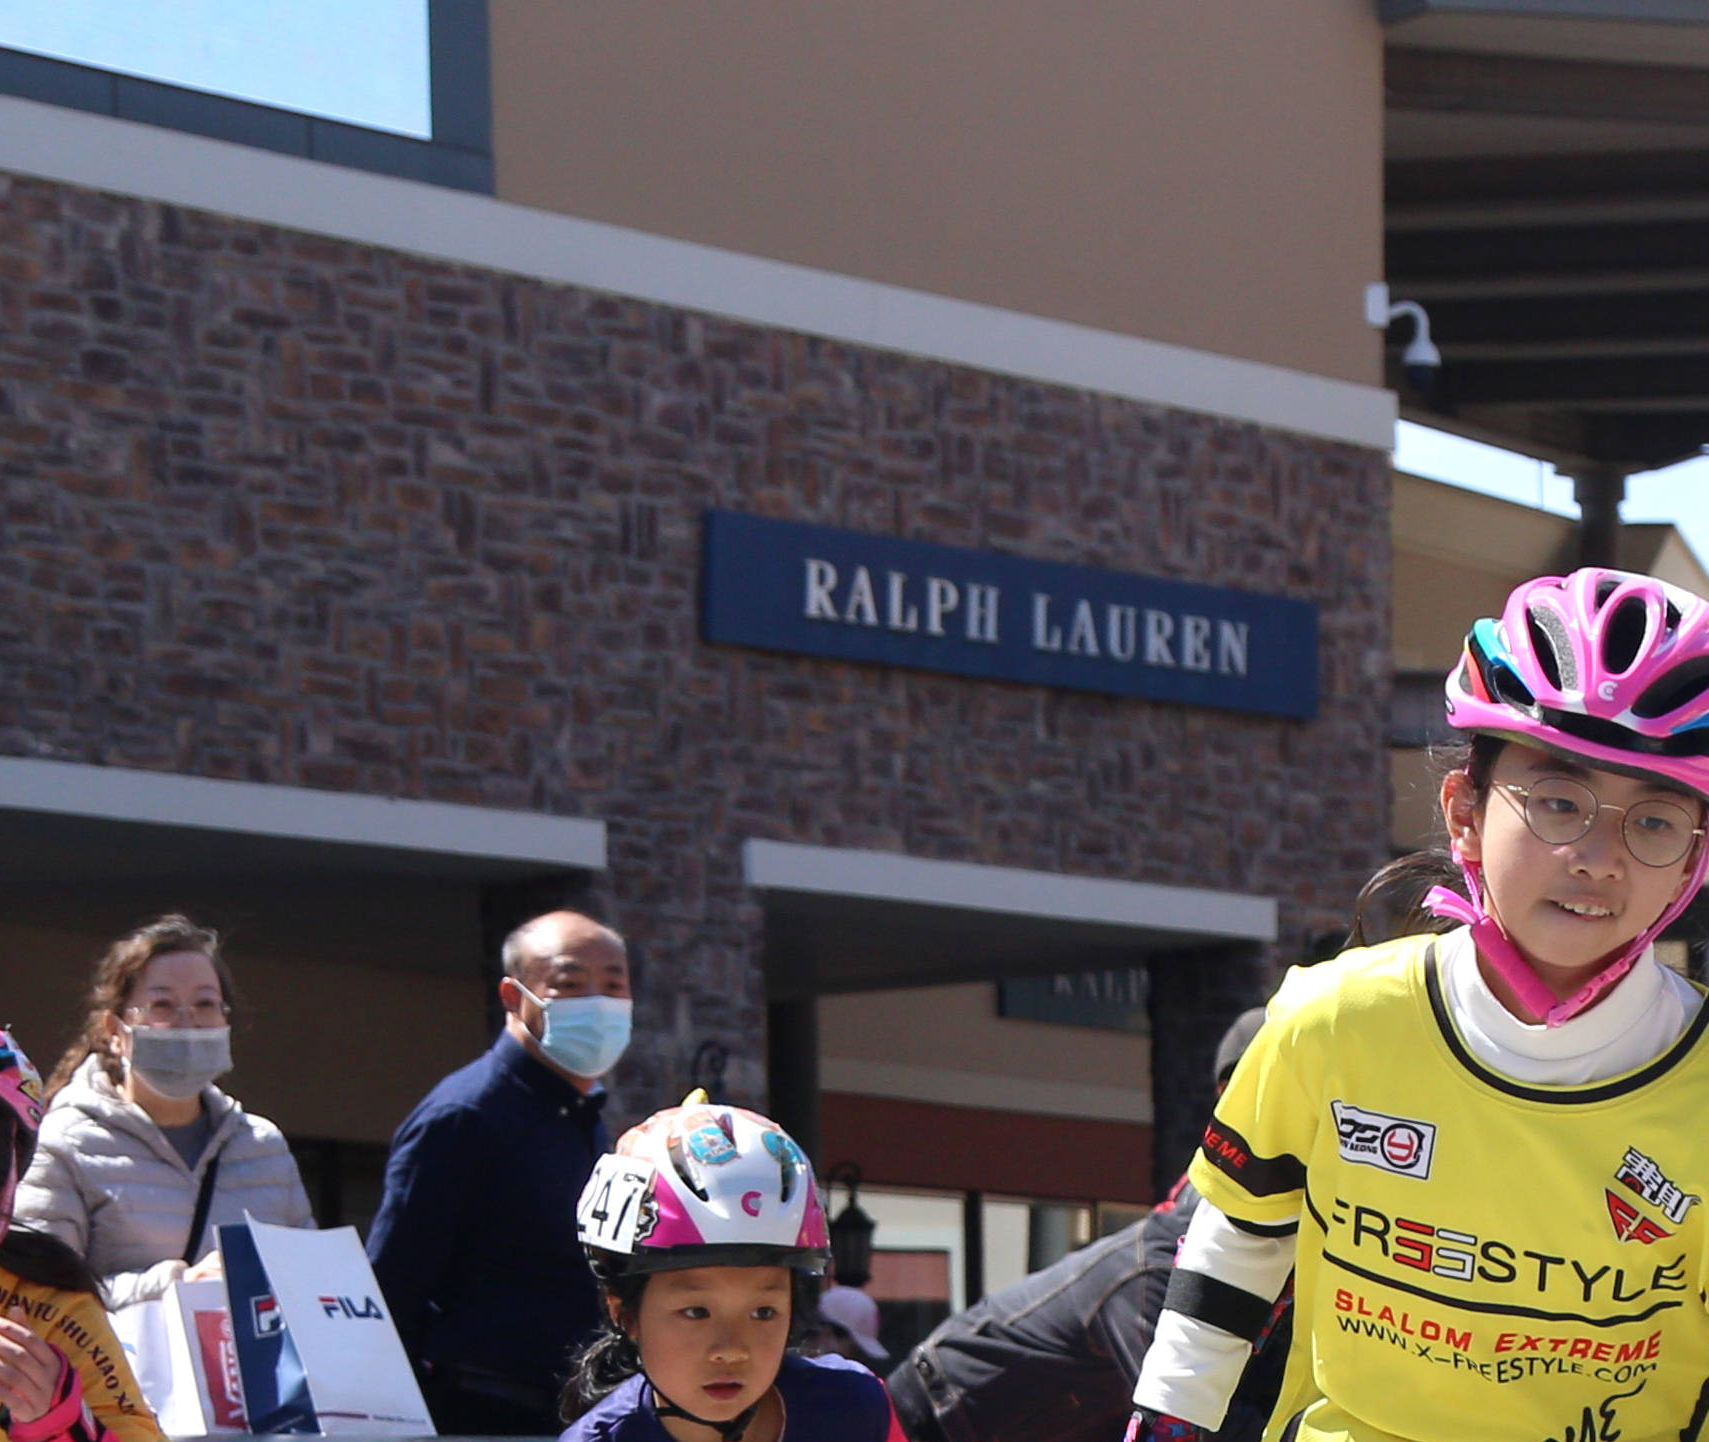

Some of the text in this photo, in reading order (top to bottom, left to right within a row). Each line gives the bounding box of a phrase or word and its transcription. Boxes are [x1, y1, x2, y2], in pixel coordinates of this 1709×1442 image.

[804, 557, 1251, 678] RALPH LAUREN
[317, 1295, 385, 1321] FILA
[1334, 1288, 1662, 1364] SLALOM EXTREME
